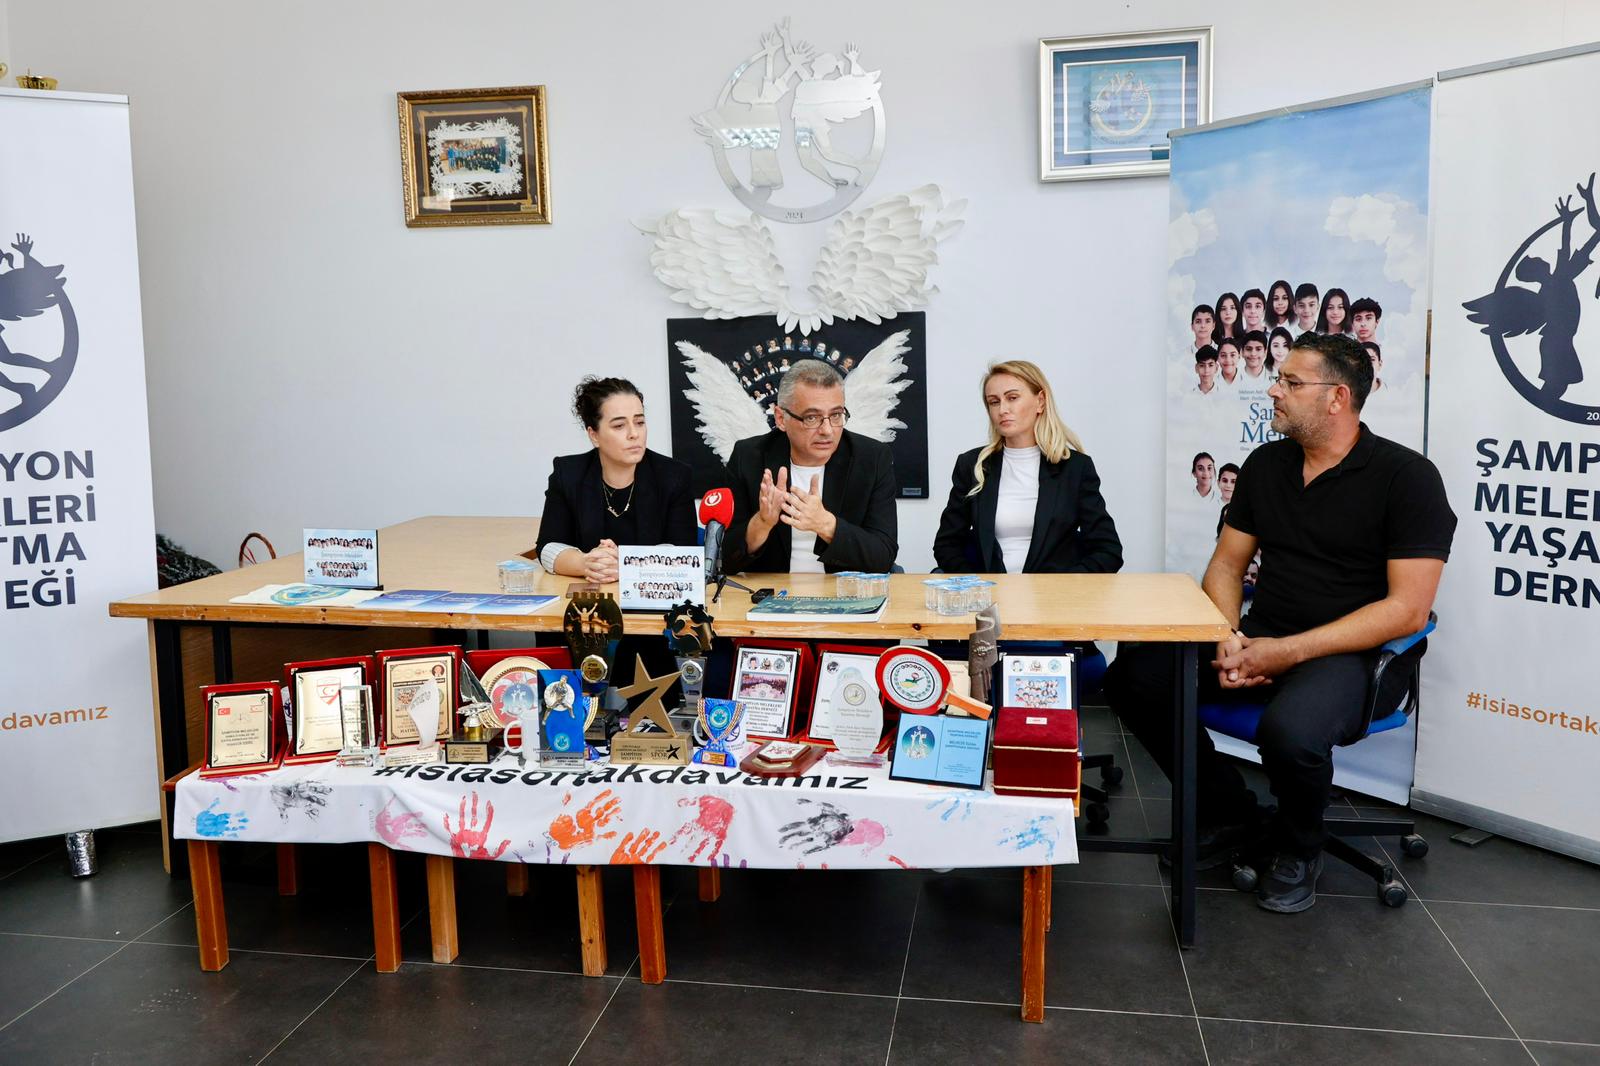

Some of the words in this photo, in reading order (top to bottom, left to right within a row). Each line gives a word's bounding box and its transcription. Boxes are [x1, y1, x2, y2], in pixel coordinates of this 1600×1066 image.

[1586, 411, 1600, 421] 20
[0, 450, 94, 482] YON
[1475, 437, 1600, 477] ŞAMP
[3, 485, 97, 526] LERİ
[1484, 521, 1600, 568] YAŞA
[5, 568, 76, 610] EĞİ
[1, 706, 108, 731] davamız
